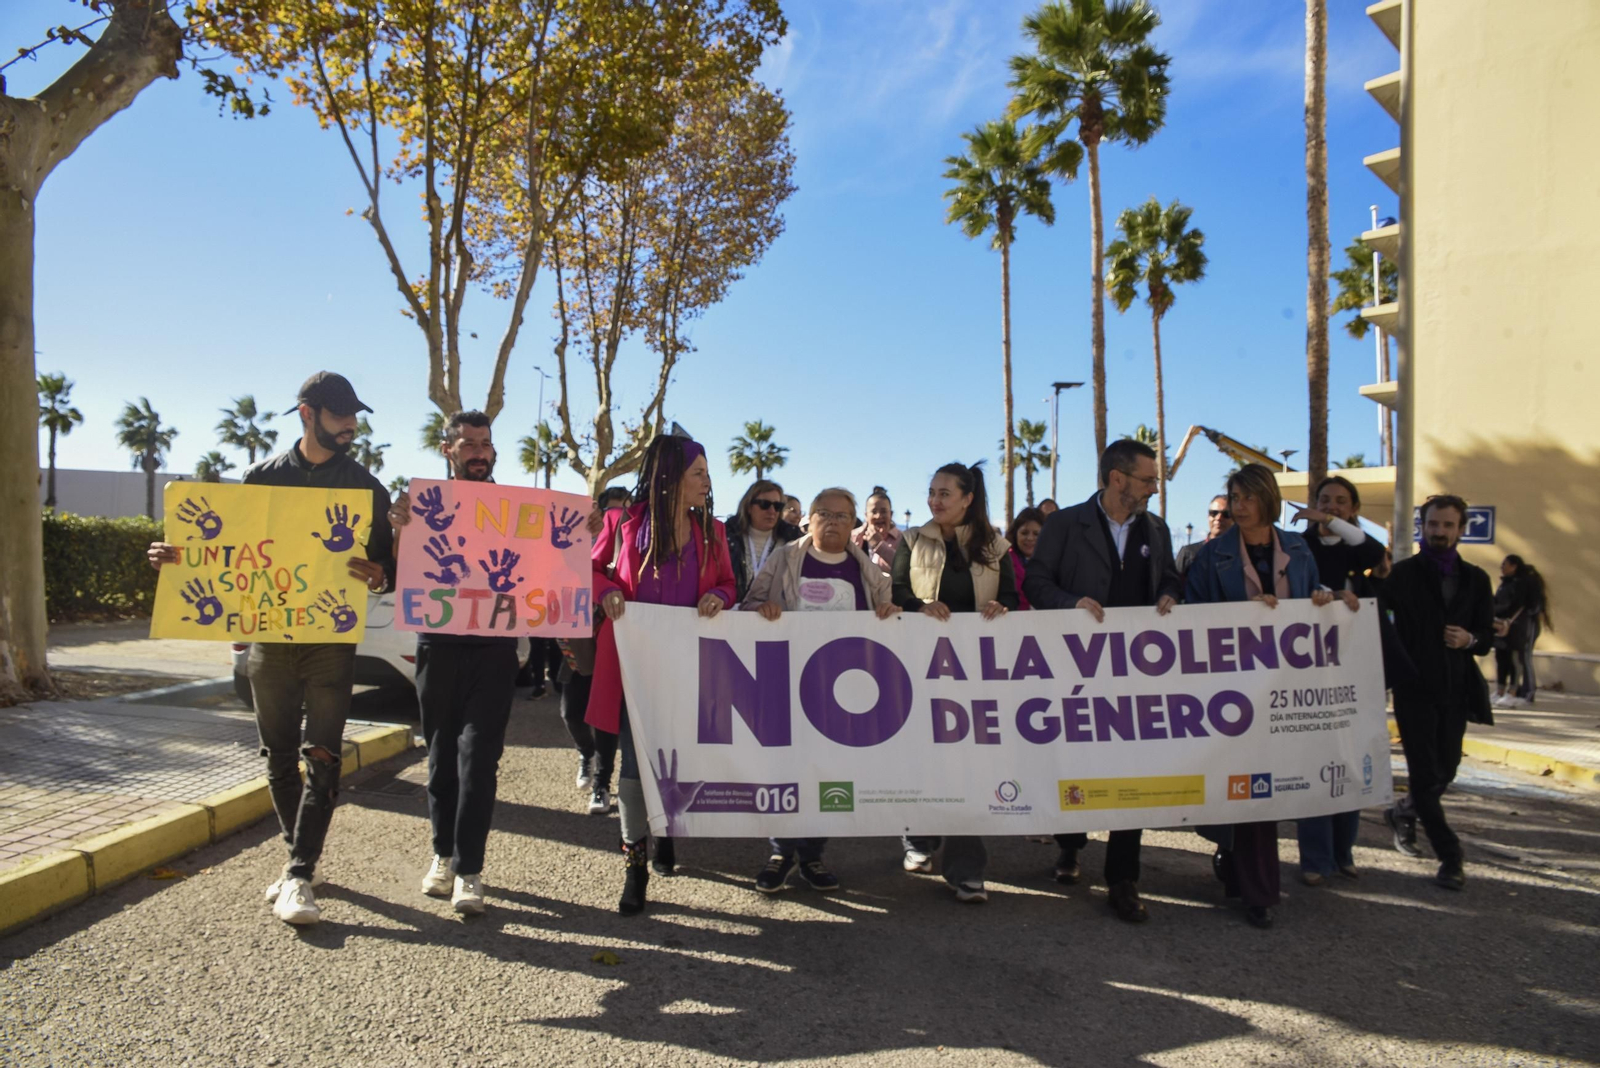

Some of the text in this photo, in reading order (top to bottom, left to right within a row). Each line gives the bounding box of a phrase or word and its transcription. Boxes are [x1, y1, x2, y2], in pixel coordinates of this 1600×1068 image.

[475, 497, 546, 540] NO
[218, 564, 308, 593] SOMOS
[239, 591, 288, 612] MAS
[403, 586, 591, 631] ESTA SOLA
[226, 605, 316, 635] FUERTES
[925, 622, 1341, 681] A LA VIOLENCIA
[697, 636, 913, 748] NO
[1269, 690, 1288, 709] 25
[930, 685, 1255, 745] DE GÉNERO
[1270, 711, 1284, 722] DÍA
[1270, 725, 1280, 734] LA
[1281, 723, 1321, 733] VIOLENCIA
[1322, 722, 1332, 731] DE
[755, 786, 797, 812] 016
[1232, 782, 1246, 794] IC
[1274, 782, 1311, 793] IGUALDAD
